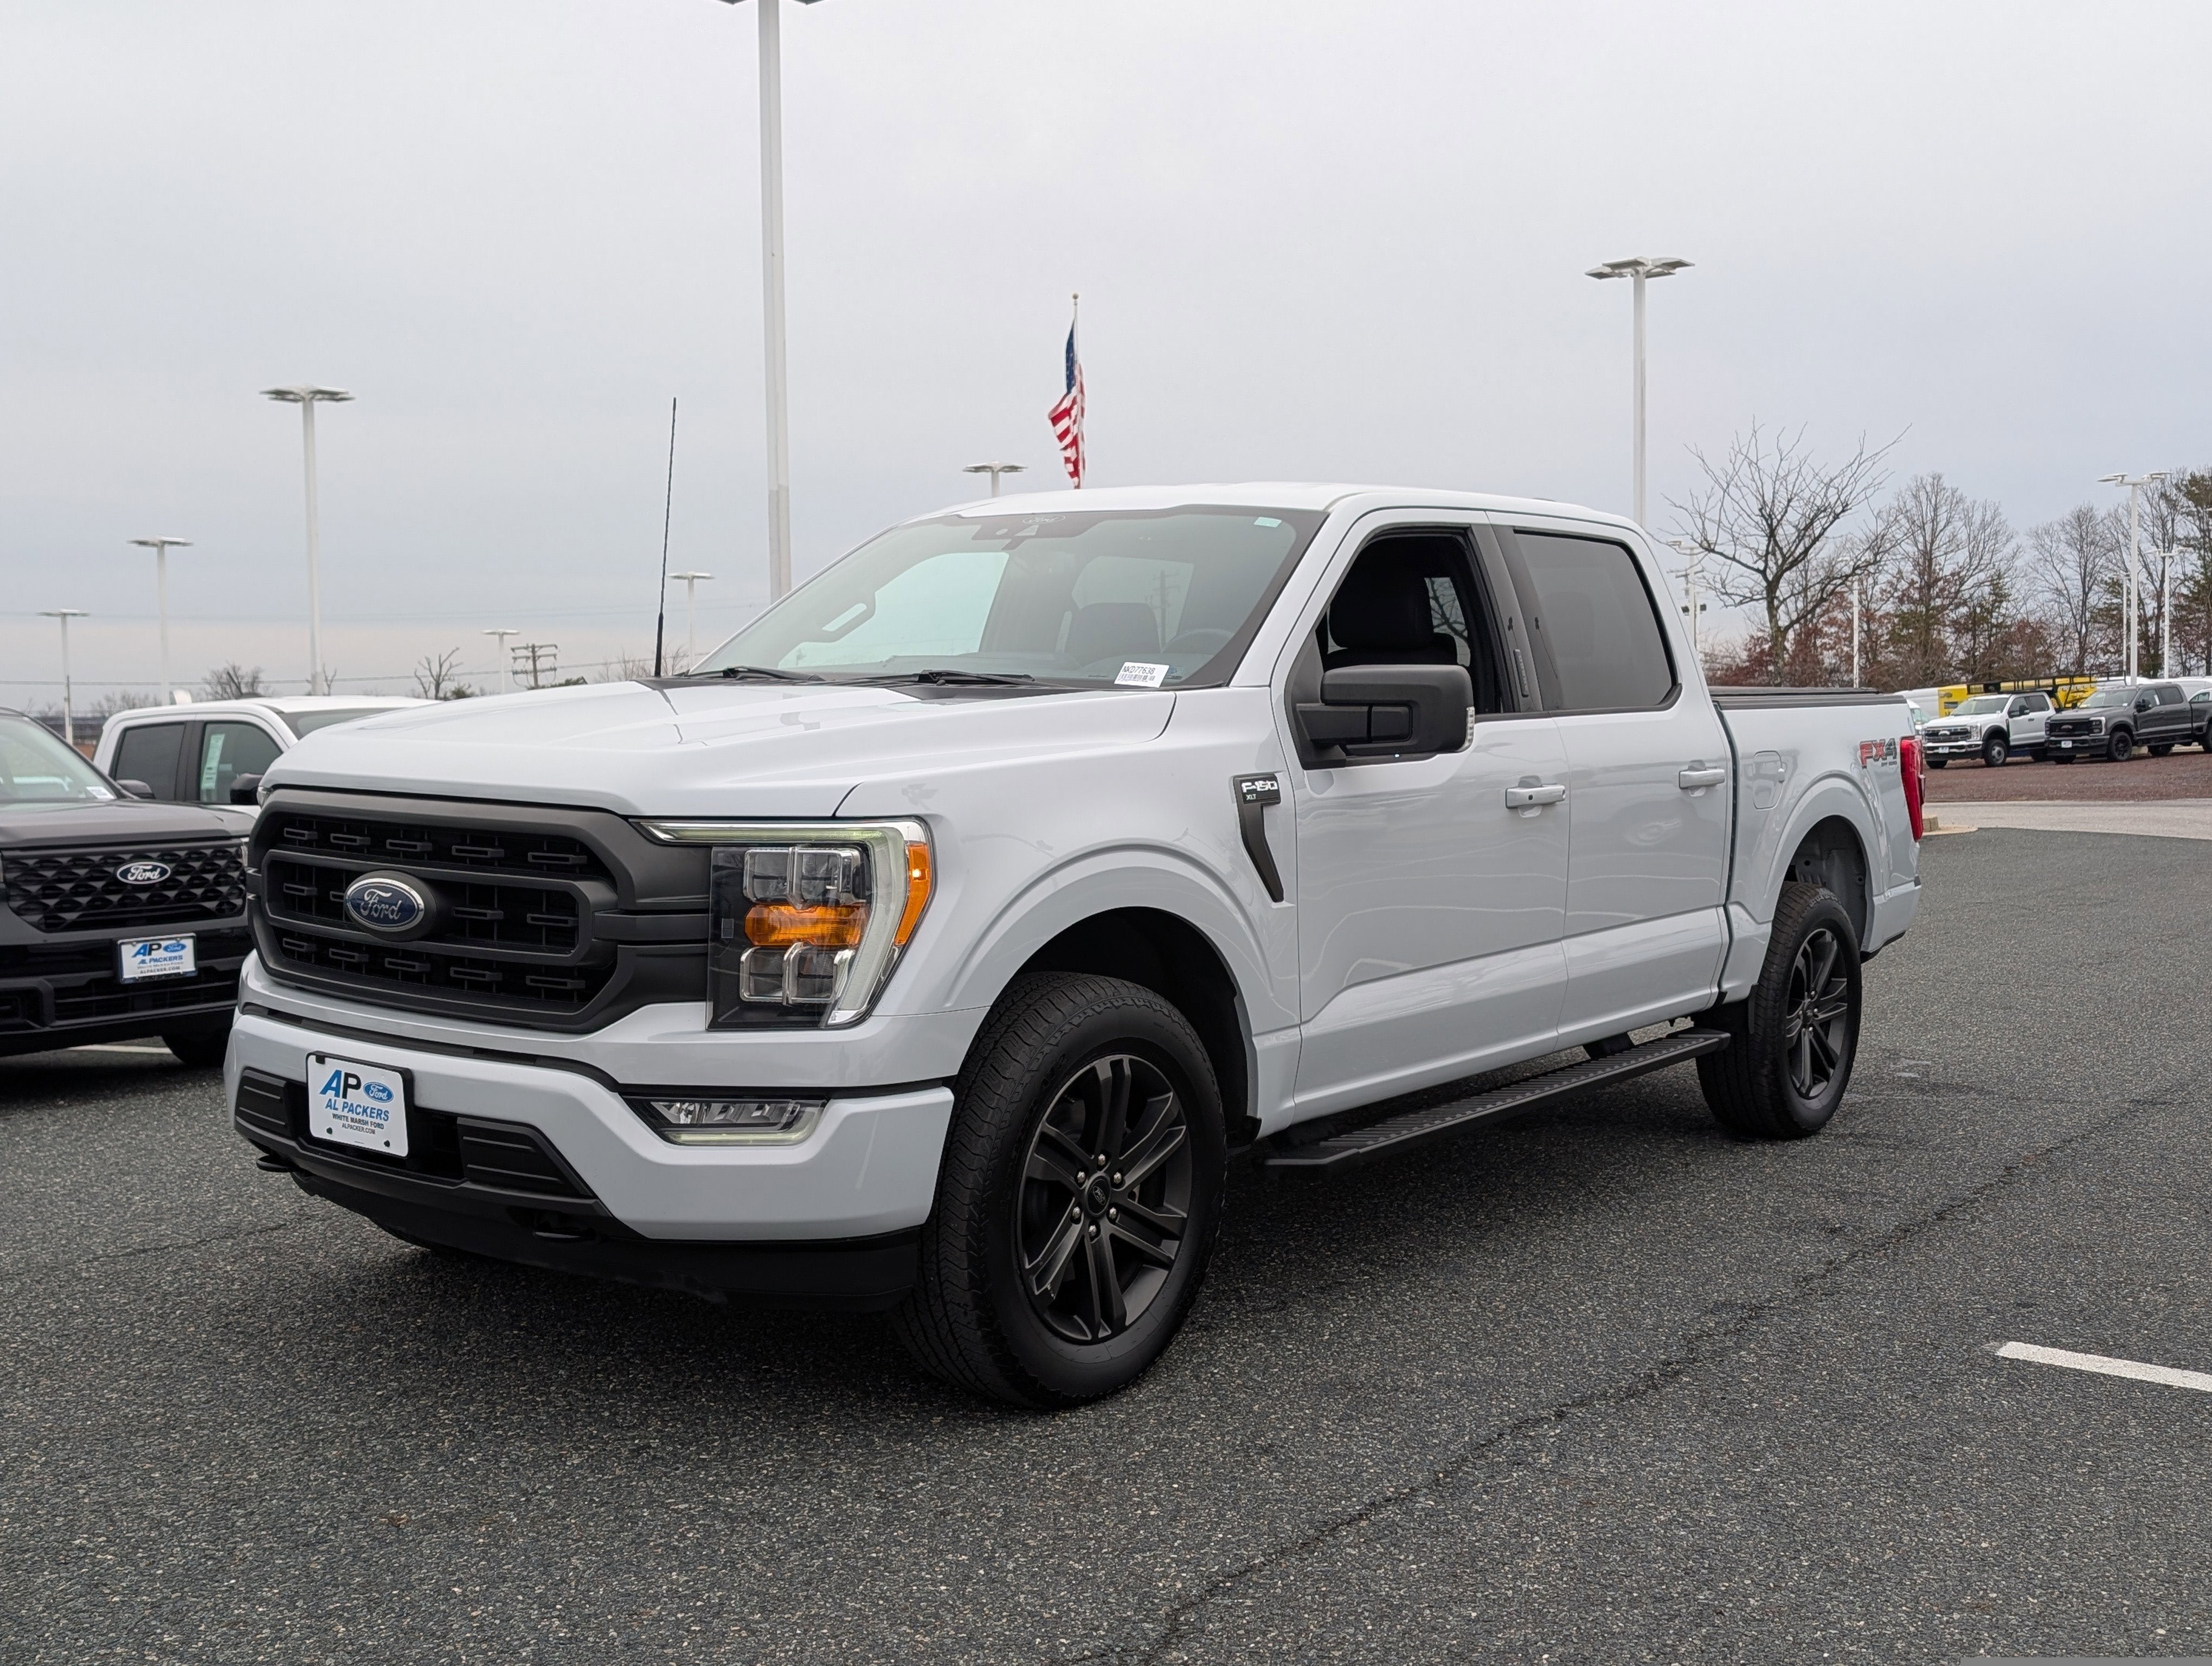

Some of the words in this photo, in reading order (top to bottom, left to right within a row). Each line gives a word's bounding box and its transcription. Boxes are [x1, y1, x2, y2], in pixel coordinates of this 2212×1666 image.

[1860, 738, 1897, 769] FX4
[1242, 780, 1278, 793] F-150
[127, 865, 160, 880] Ford
[360, 888, 402, 920] Ford
[131, 943, 162, 958] AP
[149, 954, 183, 963] PACKERS
[319, 1069, 362, 1099] AP
[369, 1084, 388, 1100] Ford
[325, 1098, 338, 1111] AL
[342, 1101, 389, 1122] PACKERS
[331, 1113, 349, 1122] WHITE
[370, 1121, 384, 1130] FORD
[342, 1123, 376, 1135] ALPACKER.COM
